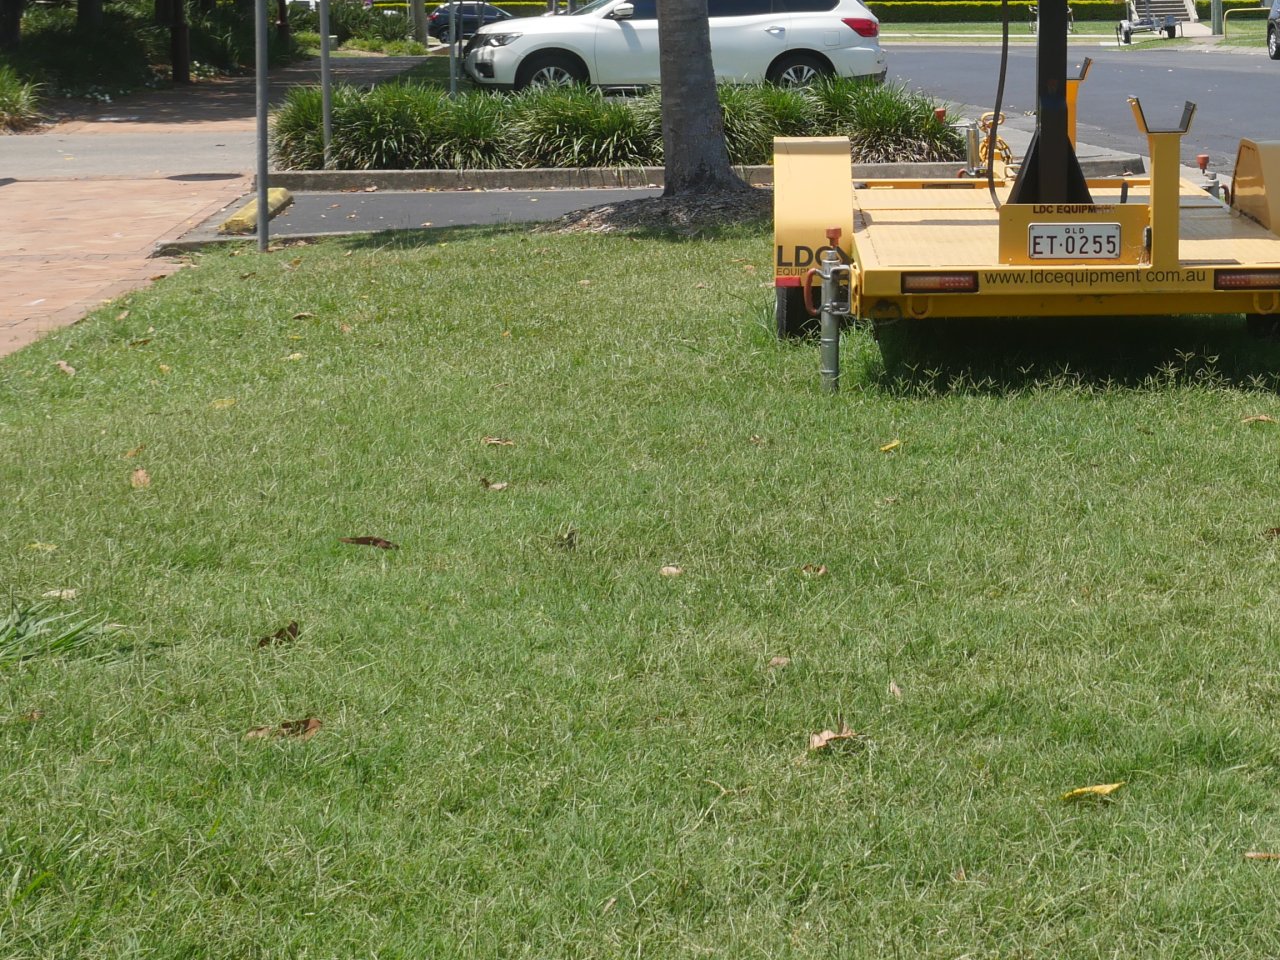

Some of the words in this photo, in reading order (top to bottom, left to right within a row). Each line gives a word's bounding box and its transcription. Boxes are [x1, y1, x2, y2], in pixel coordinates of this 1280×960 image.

[1033, 205, 1054, 214] LDC
[1057, 205, 1115, 214] EQUIPM
[985, 269, 1206, 286] www.ldcequipmentcom.au
